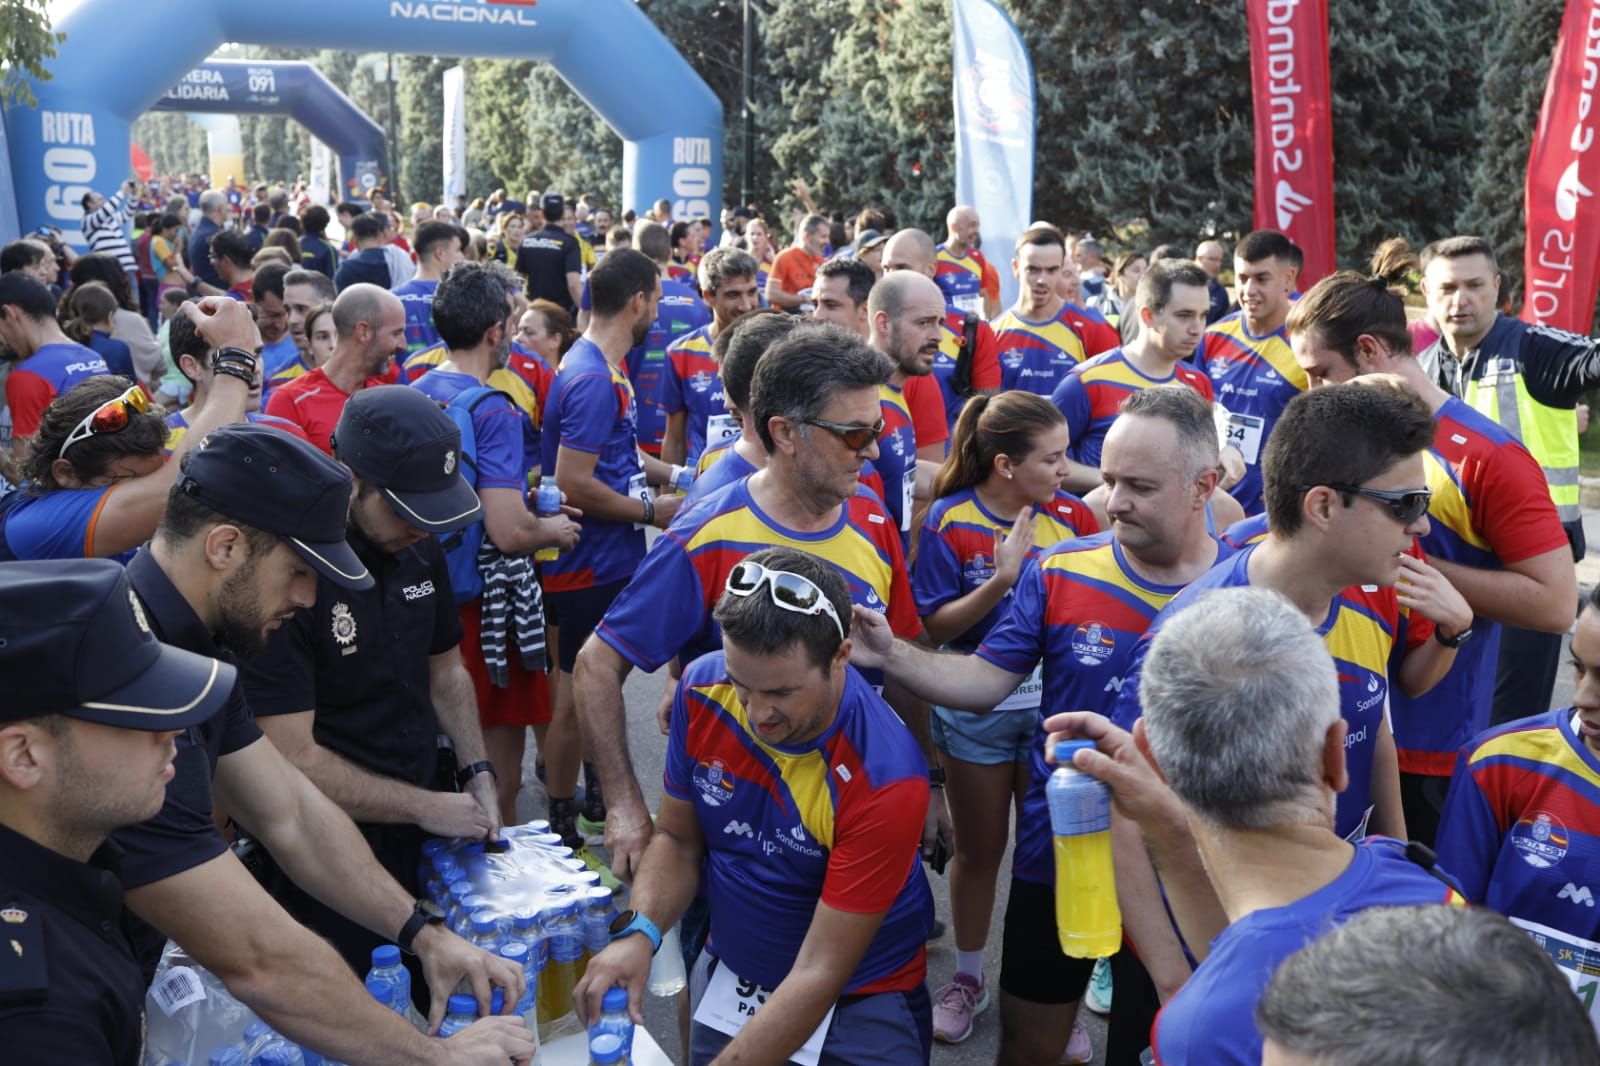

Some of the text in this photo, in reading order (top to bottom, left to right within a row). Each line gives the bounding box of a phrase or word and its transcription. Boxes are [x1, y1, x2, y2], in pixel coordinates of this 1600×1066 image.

[390, 2, 537, 26] NACIONAL
[164, 84, 229, 100] LIDARIA
[249, 76, 276, 93] 091
[42, 110, 96, 146] RUTA
[673, 137, 711, 165] RUTA
